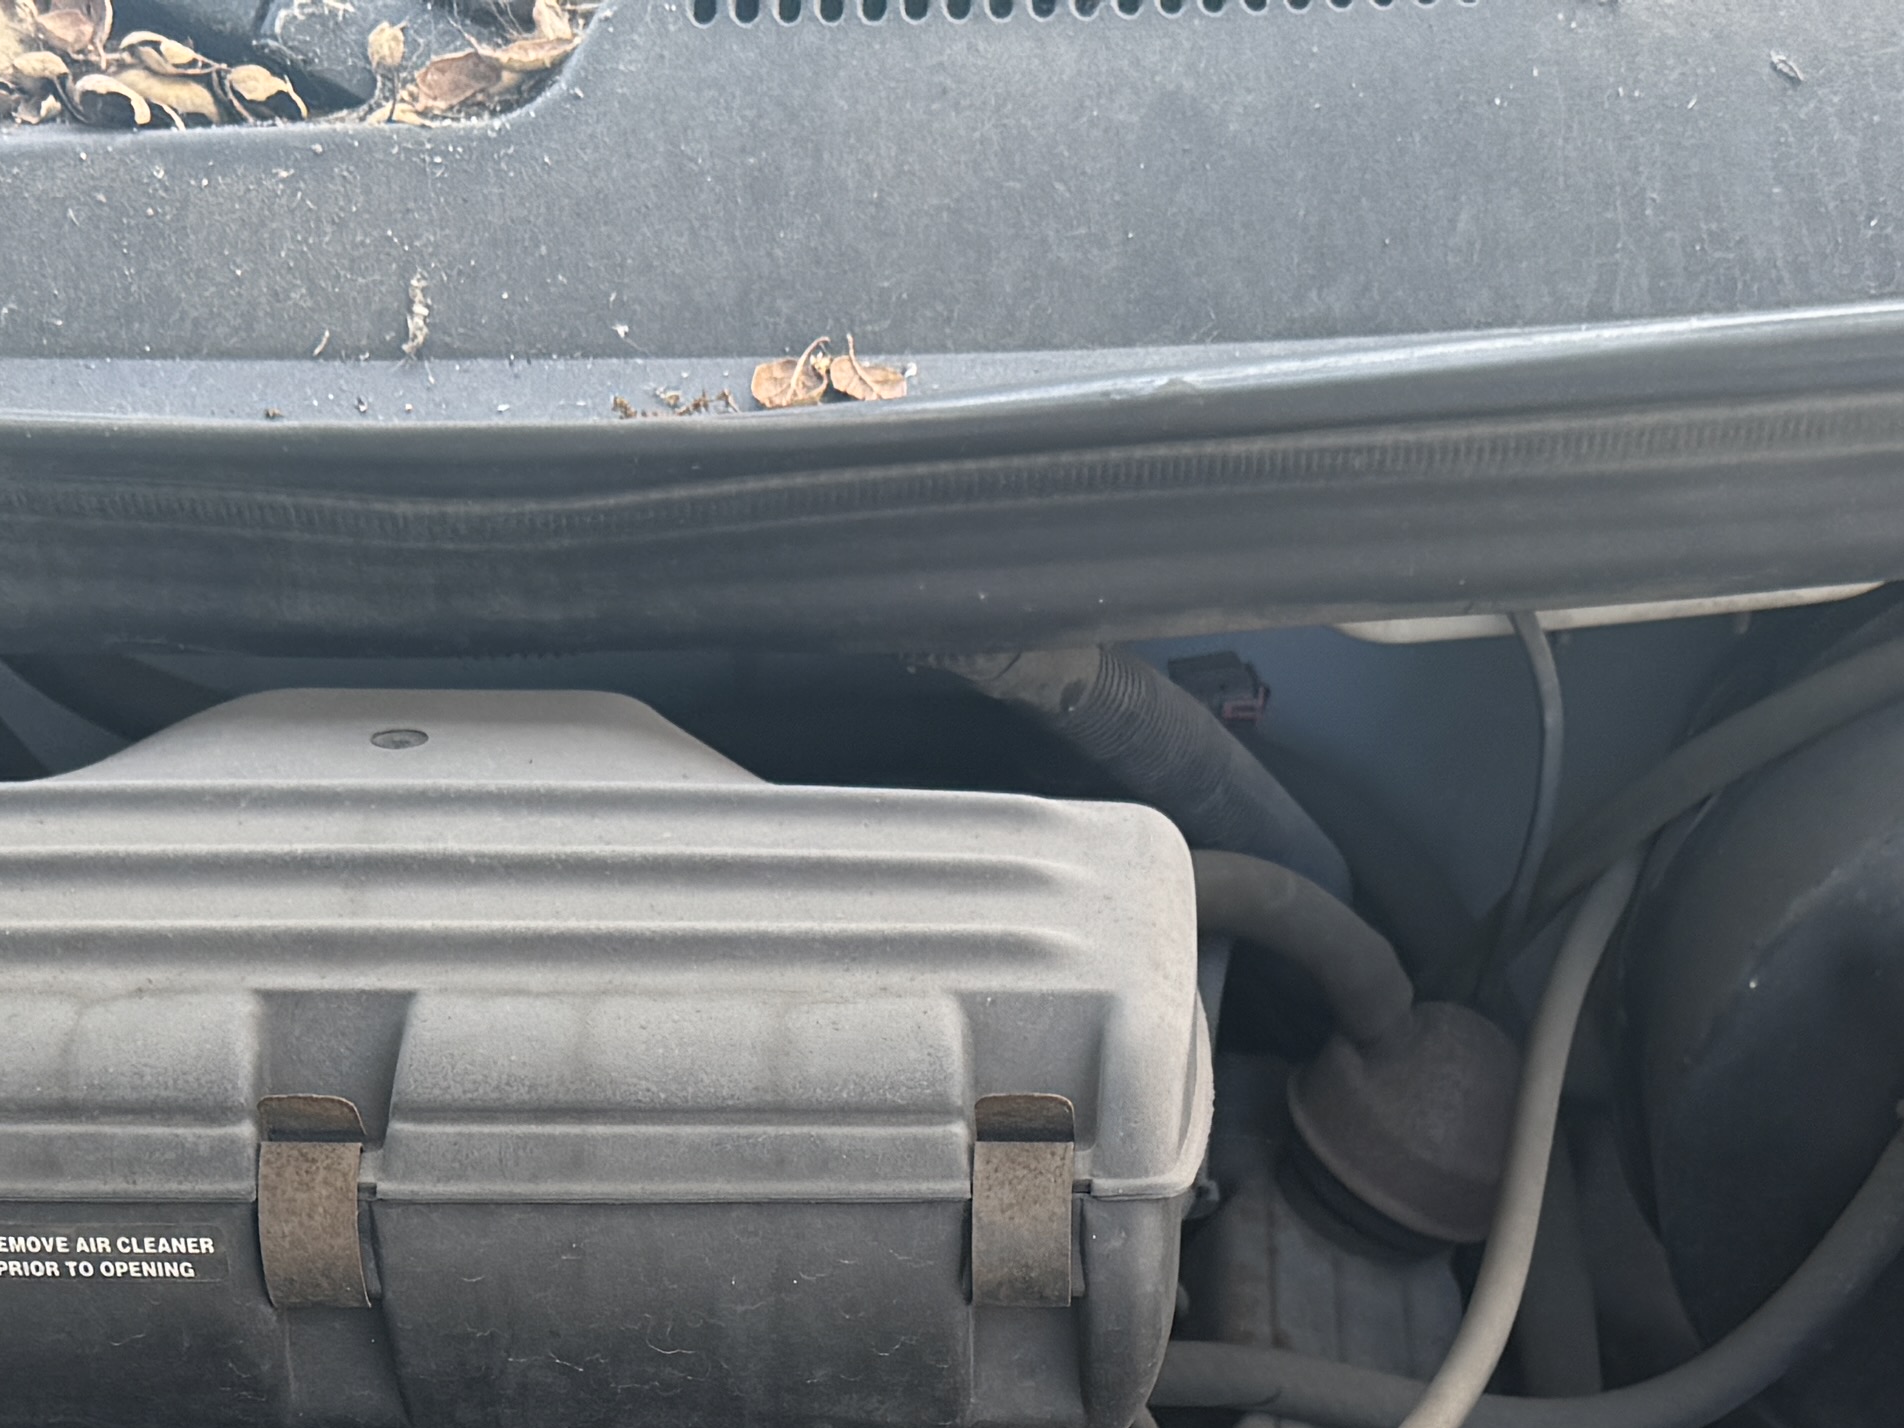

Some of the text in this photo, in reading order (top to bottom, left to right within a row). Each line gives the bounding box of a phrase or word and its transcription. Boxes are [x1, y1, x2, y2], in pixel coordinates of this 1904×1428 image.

[76, 1236, 110, 1254] AIR
[116, 1237, 214, 1254] CLEANER
[65, 1261, 94, 1277] TO
[100, 1262, 195, 1278] OPENING
